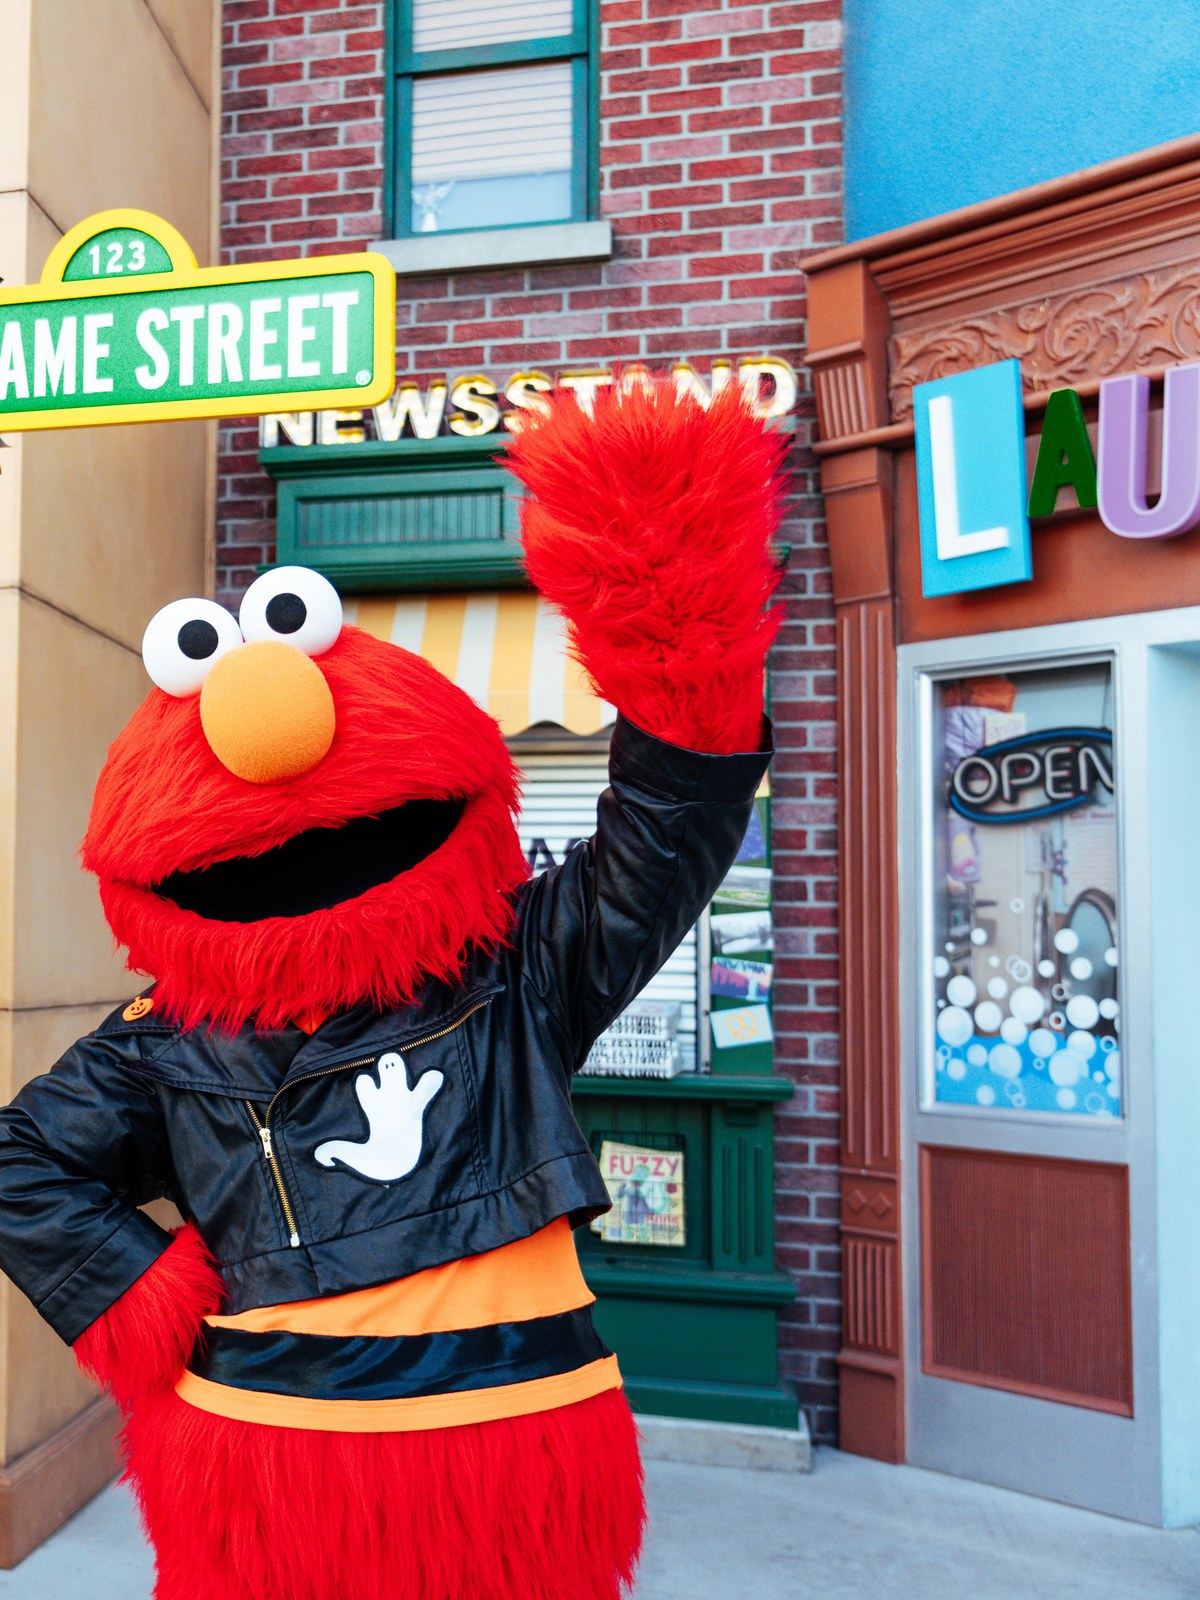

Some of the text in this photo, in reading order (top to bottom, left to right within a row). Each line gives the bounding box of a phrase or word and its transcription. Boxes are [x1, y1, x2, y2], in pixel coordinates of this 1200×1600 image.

[89, 240, 146, 274] 123
[135, 290, 359, 390] STREET
[951, 744, 1114, 805] OPEN
